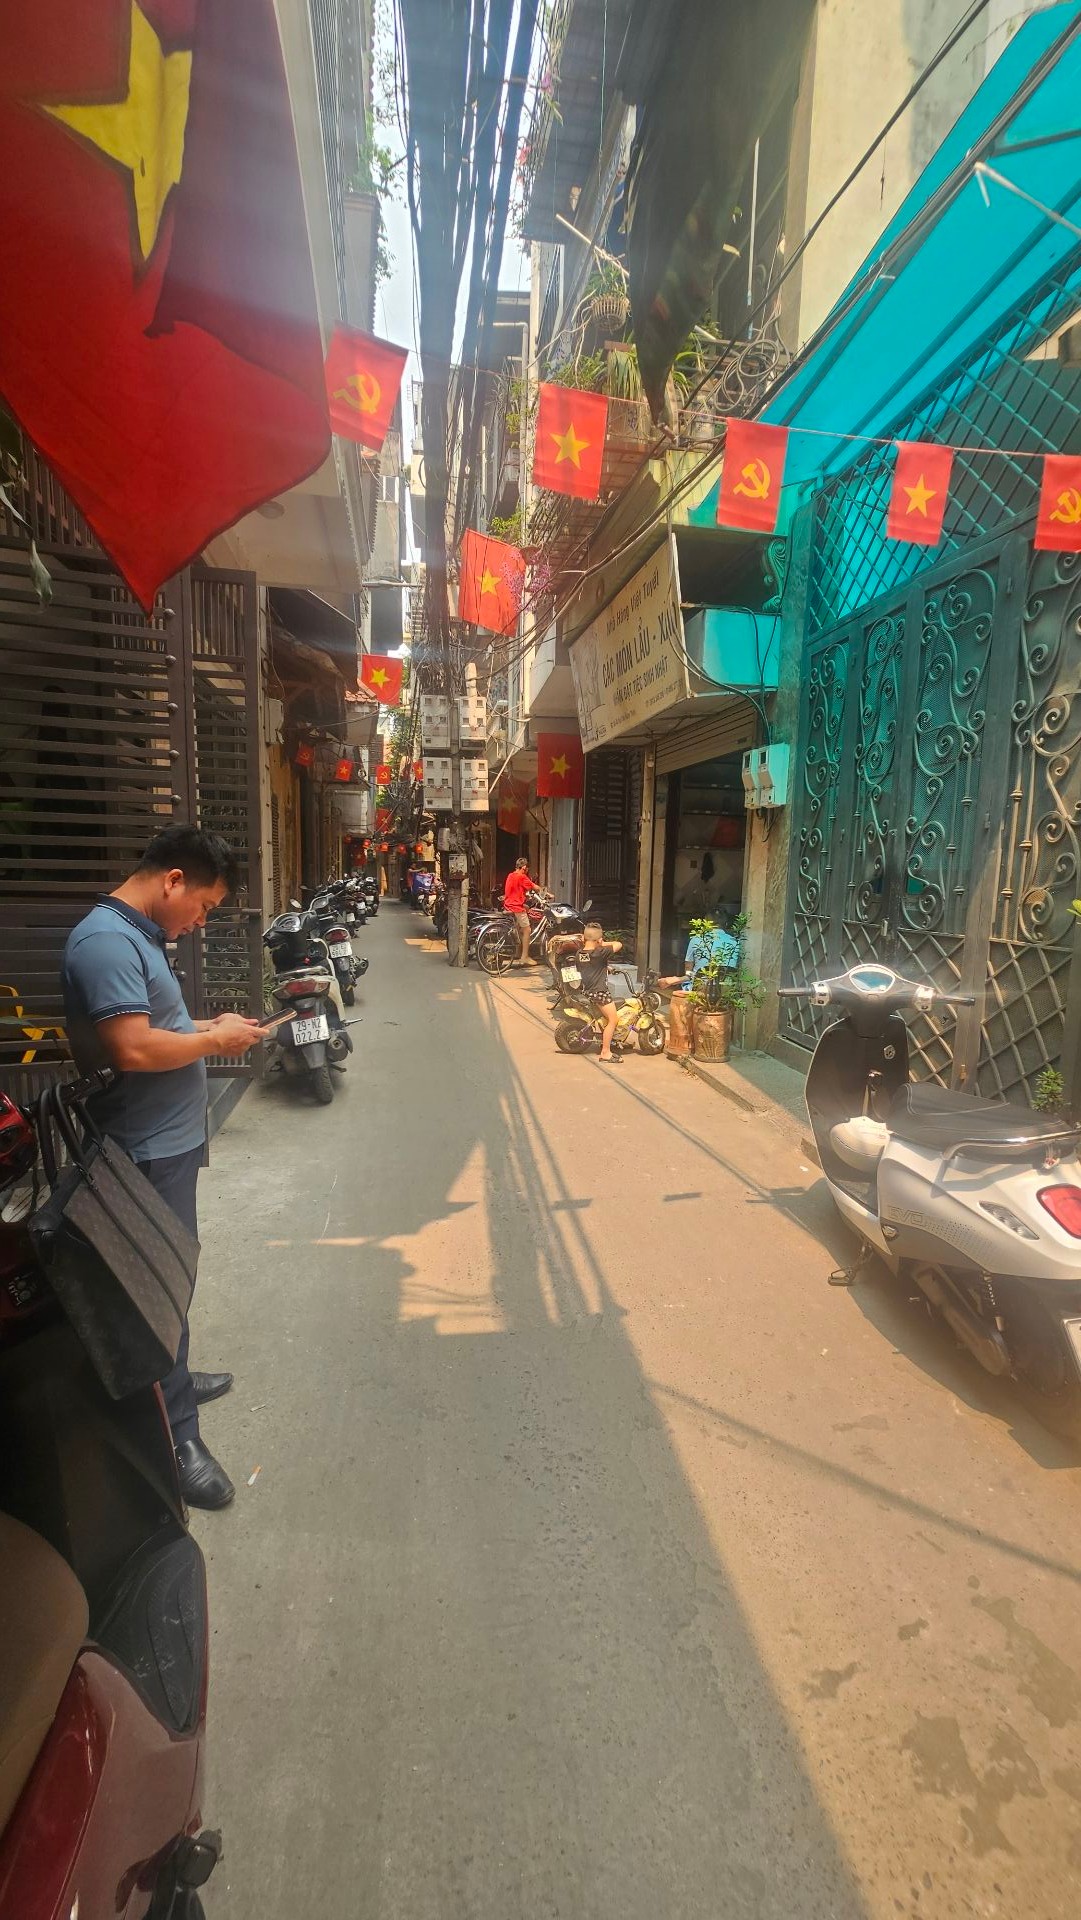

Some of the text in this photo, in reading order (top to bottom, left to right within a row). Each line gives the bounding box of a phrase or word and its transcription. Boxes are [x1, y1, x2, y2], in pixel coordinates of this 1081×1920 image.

[602, 653, 614, 688] CÁC
[616, 639, 633, 678] MÓN
[634, 616, 650, 664] LẨU
